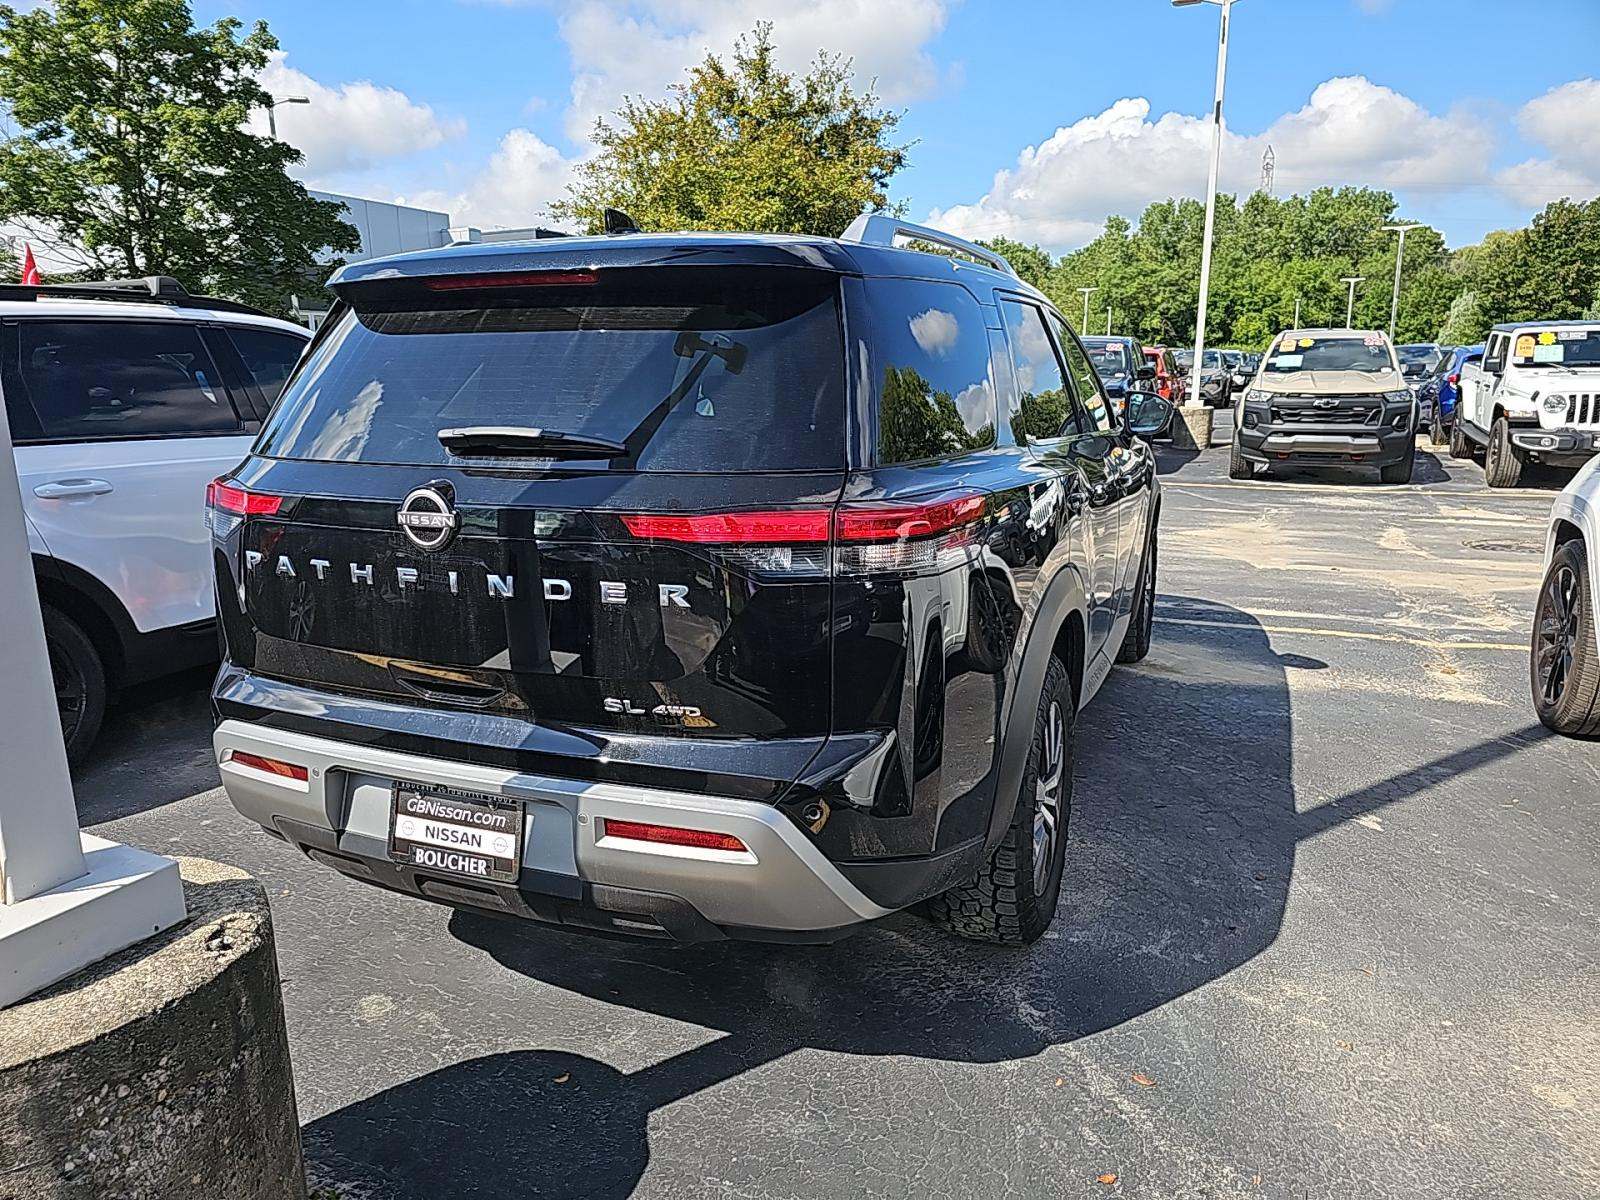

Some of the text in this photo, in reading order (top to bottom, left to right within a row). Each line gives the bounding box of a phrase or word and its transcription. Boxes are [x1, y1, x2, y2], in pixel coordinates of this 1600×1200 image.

[397, 513, 454, 528] NISSAN
[245, 550, 691, 608] PATHFINDER
[603, 697, 701, 717] SL 4WD
[407, 798, 507, 828] GBNissan.com
[425, 825, 482, 848] NISSAN
[415, 848, 488, 875] BOUCHER
